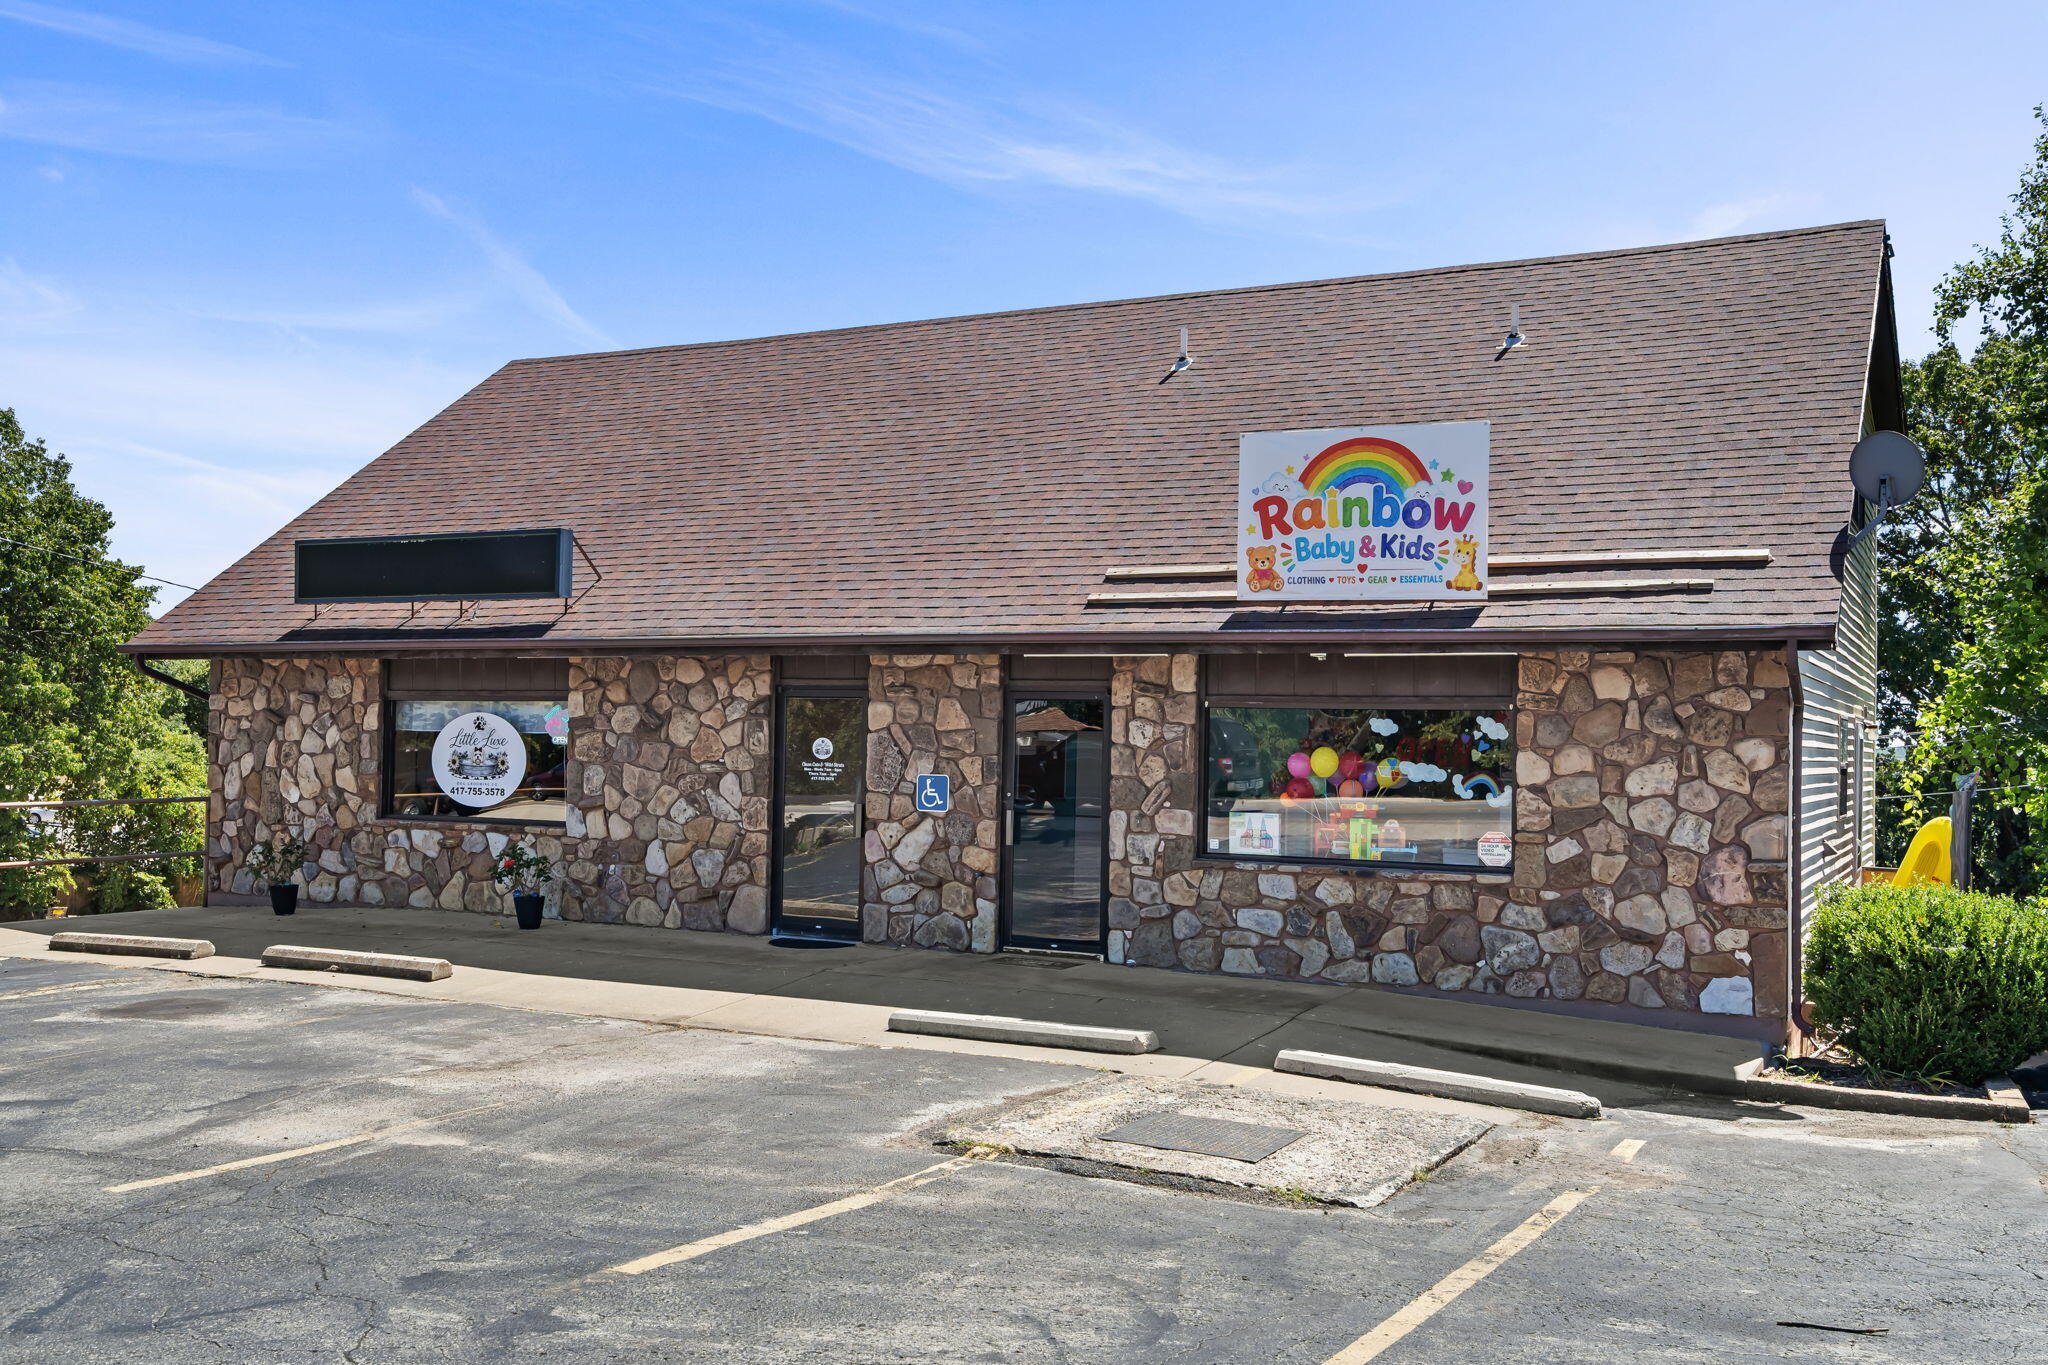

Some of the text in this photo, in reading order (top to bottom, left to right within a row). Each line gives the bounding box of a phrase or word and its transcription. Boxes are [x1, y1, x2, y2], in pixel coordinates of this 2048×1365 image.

[1253, 484, 1475, 541] Rainbow
[1295, 533, 1435, 564] Baby & Kids
[1287, 575, 1444, 585] CLOTHING TOYS GEAR ESSENTIALS
[449, 728, 509, 749] Little Luxe
[450, 787, 505, 797] 417-755-3578
